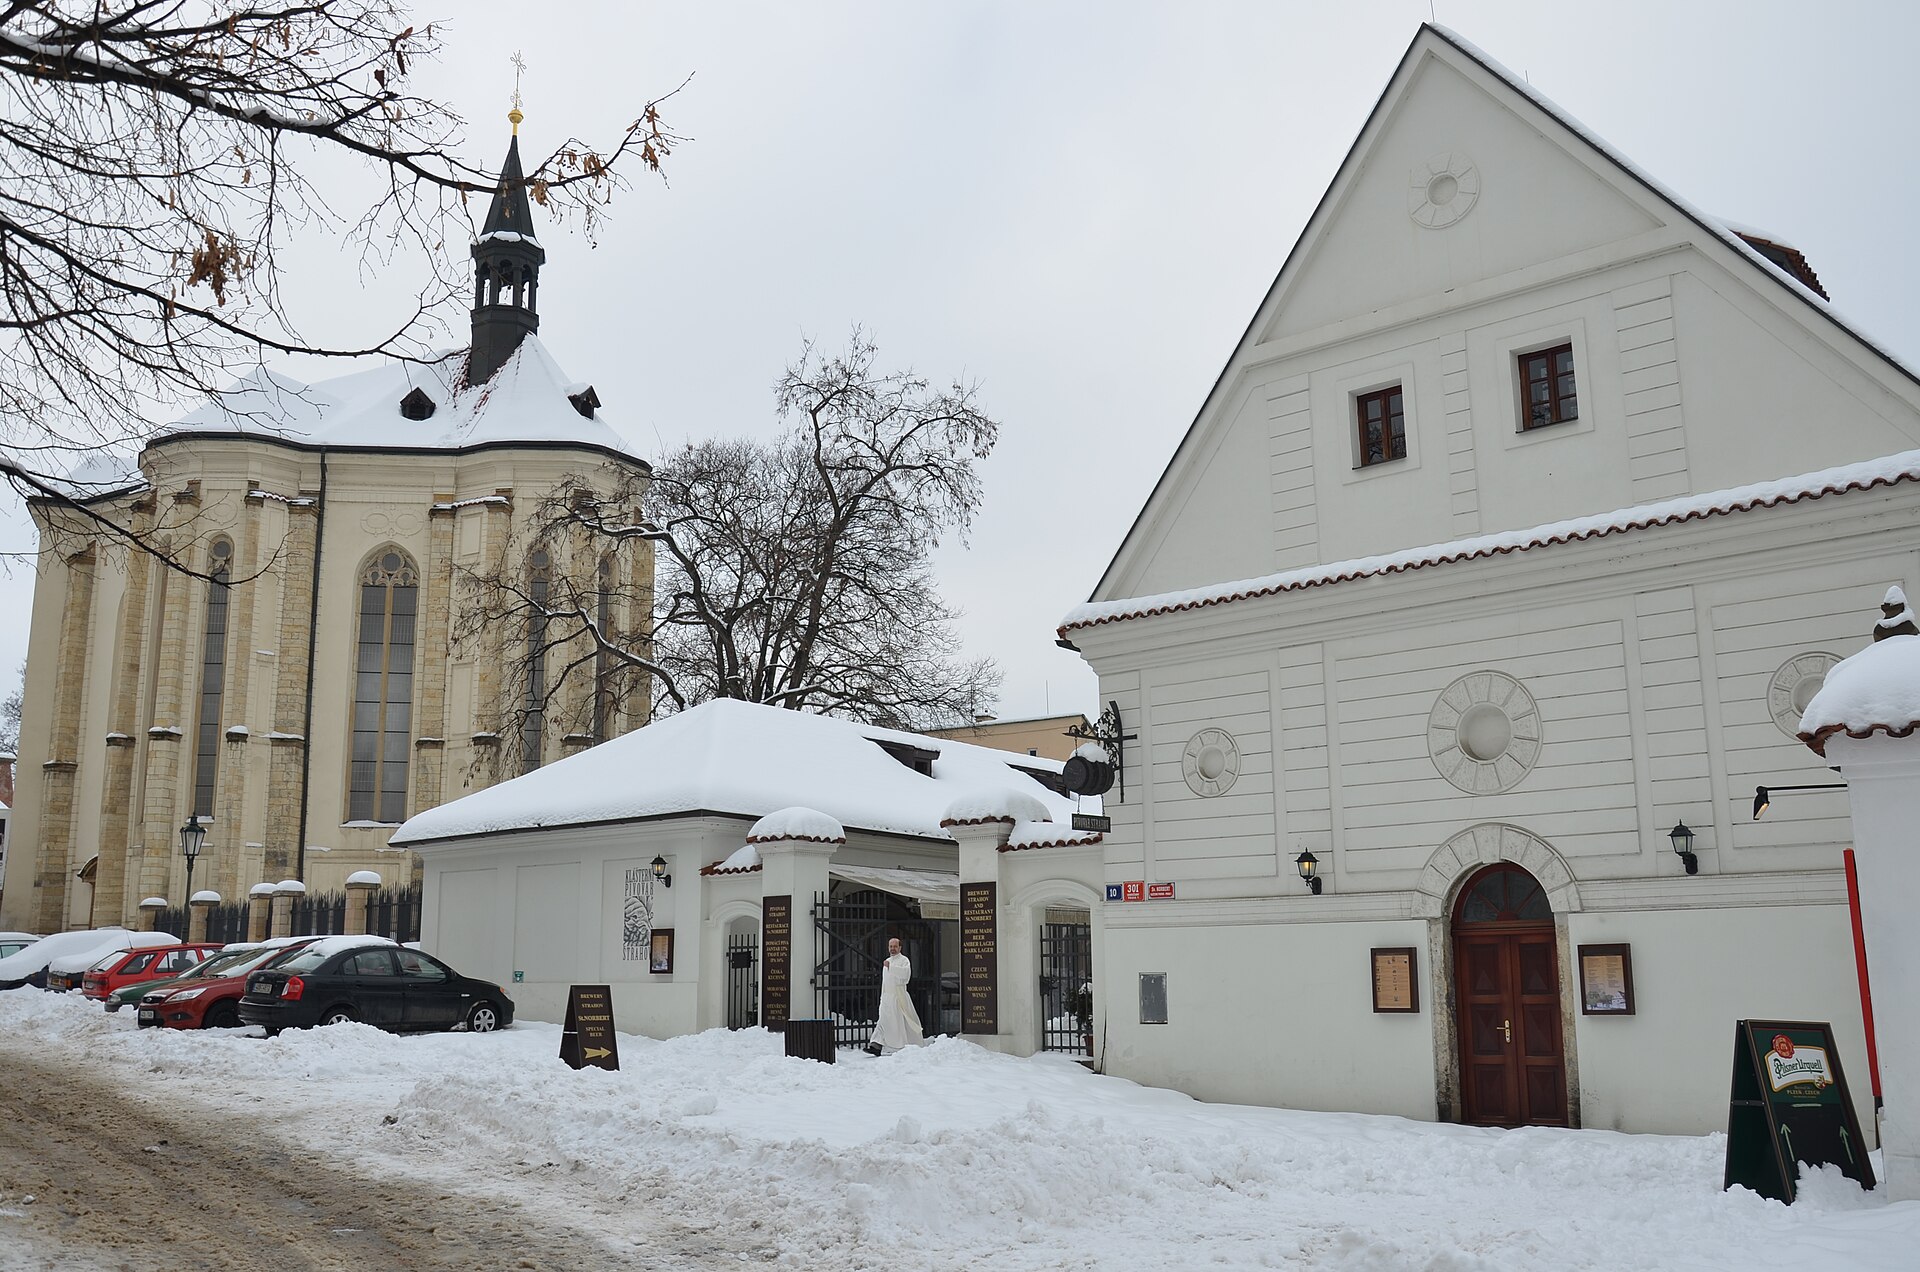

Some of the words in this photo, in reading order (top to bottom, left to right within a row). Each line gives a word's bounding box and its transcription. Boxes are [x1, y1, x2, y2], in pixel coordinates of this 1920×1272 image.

[625, 881, 654, 896] PIVOVAR
[1110, 888, 1117, 897] 10
[1127, 884, 1139, 893] 301
[623, 946, 650, 961] STRAHO
[1773, 1058, 1798, 1079] Pilsner
[1796, 1058, 1823, 1074] Urquell
